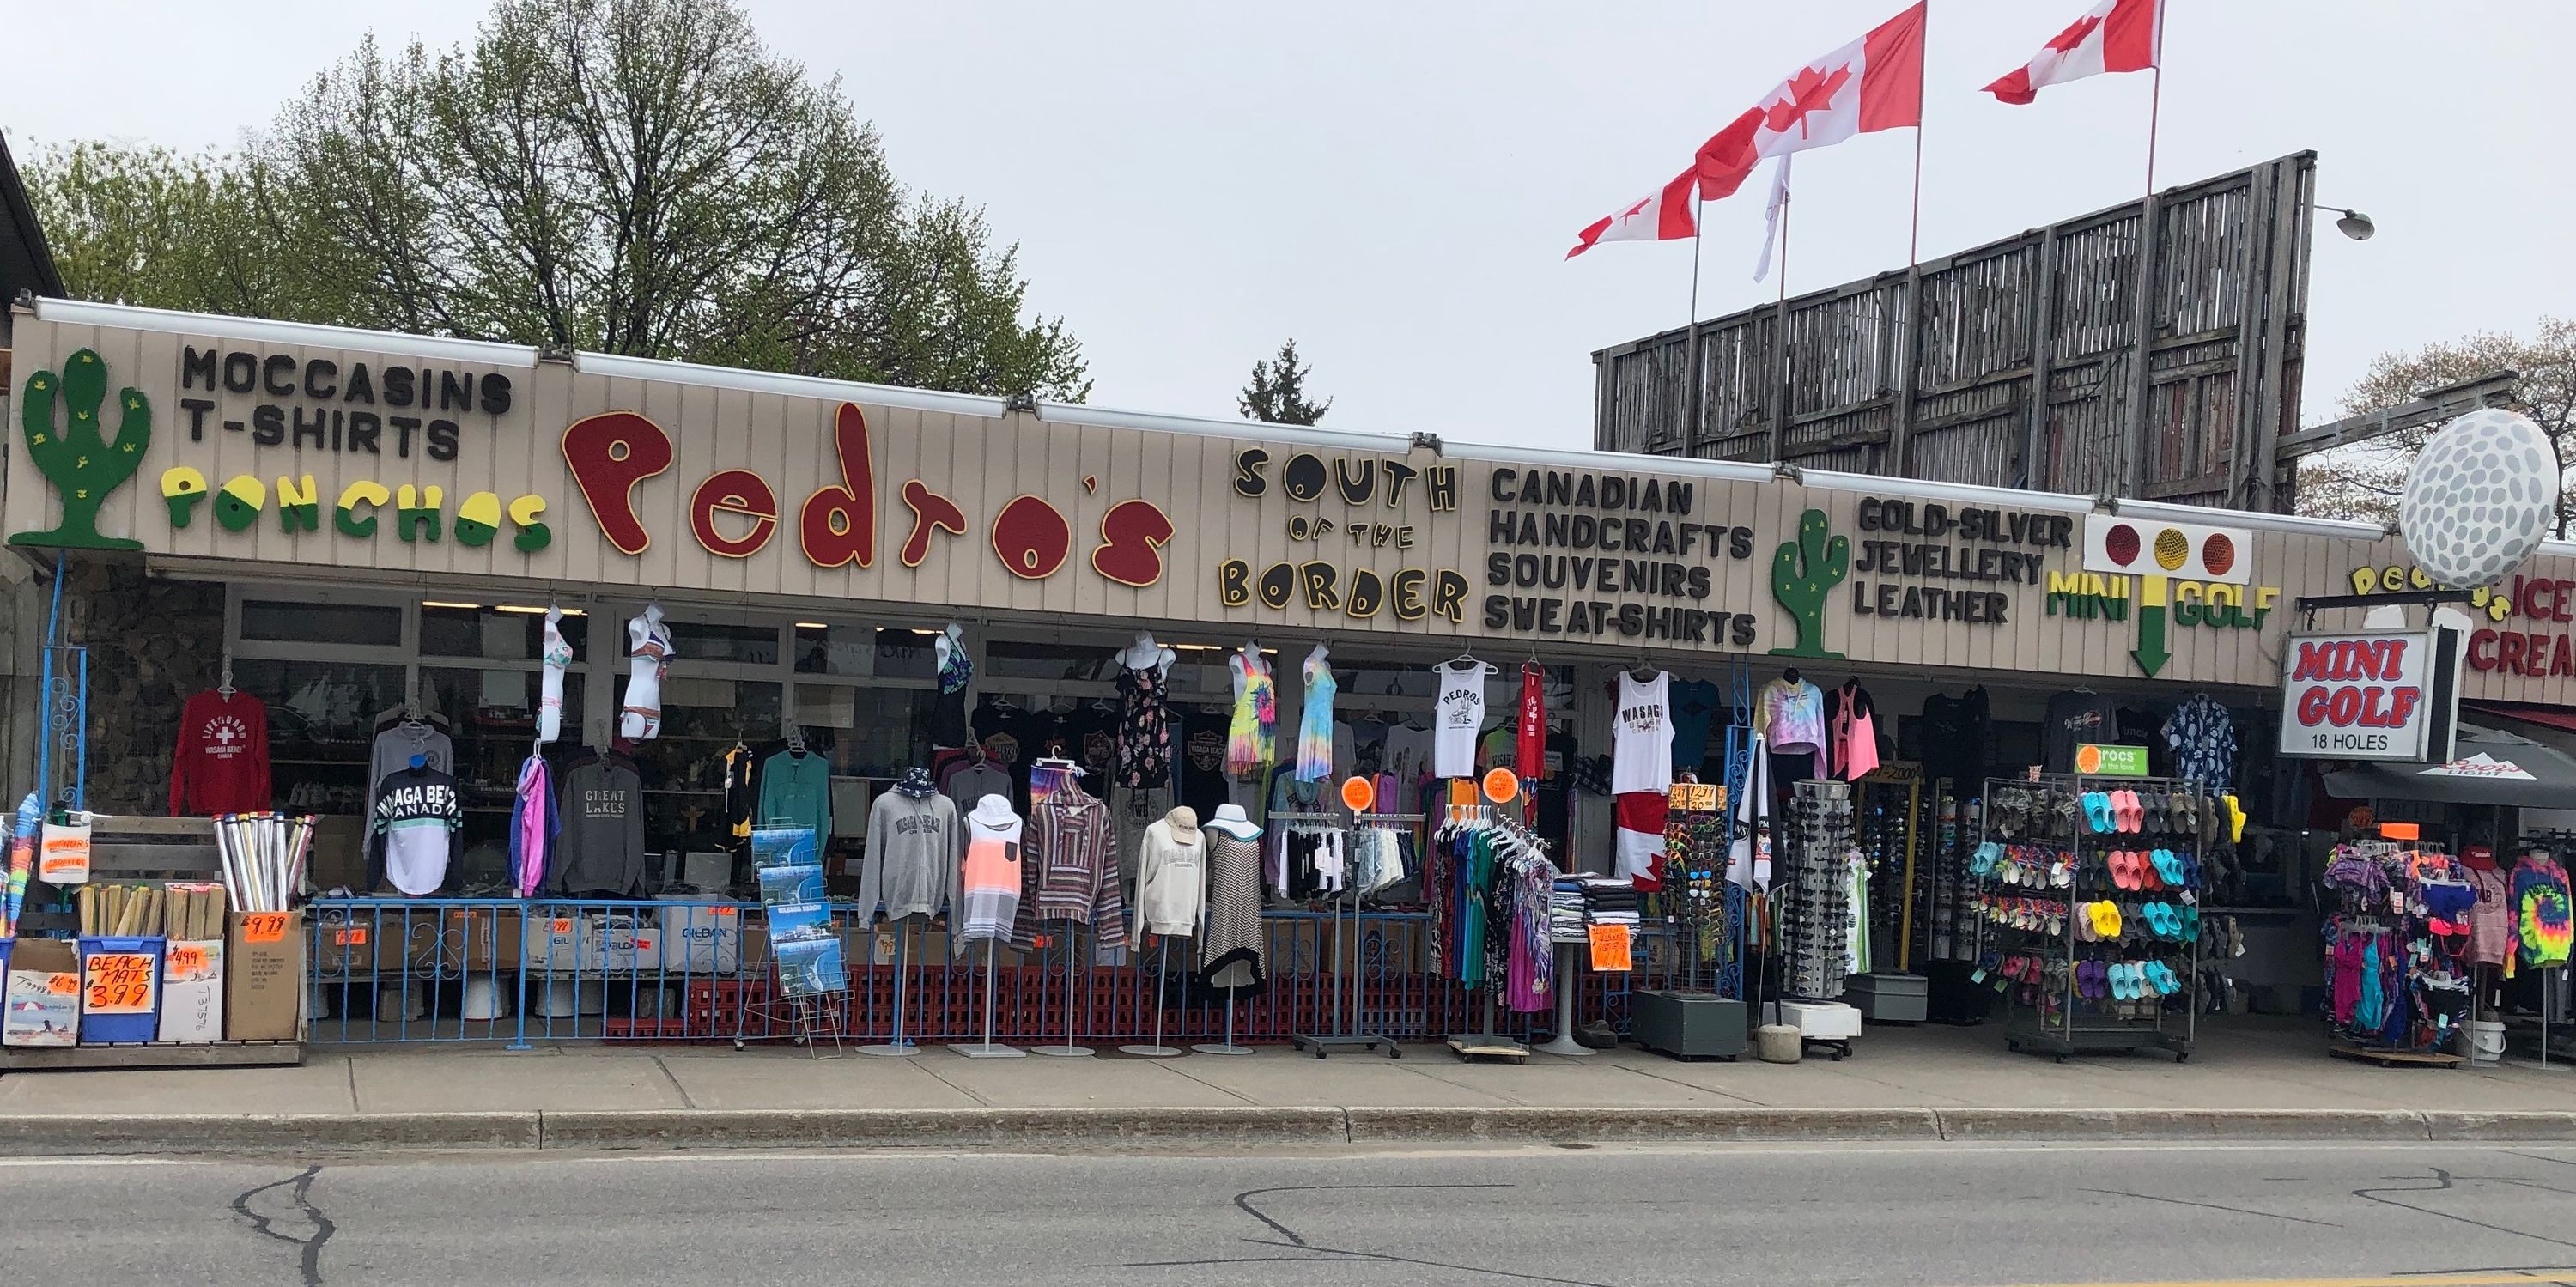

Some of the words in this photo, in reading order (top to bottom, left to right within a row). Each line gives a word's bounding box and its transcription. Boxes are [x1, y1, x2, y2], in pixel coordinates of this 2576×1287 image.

[183, 345, 511, 414] MOCCASINS
[181, 398, 459, 460] T-SHIRTS
[561, 401, 1176, 587] Pedro's
[1234, 447, 1456, 512] SOUTH
[1492, 468, 1692, 515] CANADIAN
[161, 466, 550, 551] PONCHOS
[1860, 496, 2074, 548] GOLD-SILVER
[1288, 515, 1334, 542] OF
[1346, 521, 1415, 549] THE
[1490, 510, 1753, 559] HANDCRAFTS
[1486, 552, 1711, 598] SOUVENIRS
[1856, 541, 2044, 585] JEWELLERY
[1219, 557, 1470, 622] BORDER
[1855, 580, 2008, 623] LEATHER
[2046, 571, 2129, 622] MINI
[2175, 581, 2280, 631] GOLF
[2512, 574, 2576, 622] ICE
[1485, 595, 1757, 645] SWEAT-SHIRTS
[2292, 640, 2408, 682] MINI
[2467, 628, 2576, 677] CREA
[1443, 689, 1479, 705] PEDROS
[2298, 686, 2420, 728] GOLF
[2100, 750, 2135, 762] rocs
[2312, 734, 2327, 749] 18
[2334, 734, 2388, 750] HOLES
[394, 804, 443, 817] ANAD
[586, 790, 626, 801] GREAT
[586, 802, 625, 813] LAKES
[88, 956, 155, 971] BEACH
[100, 968, 153, 984] MATS
